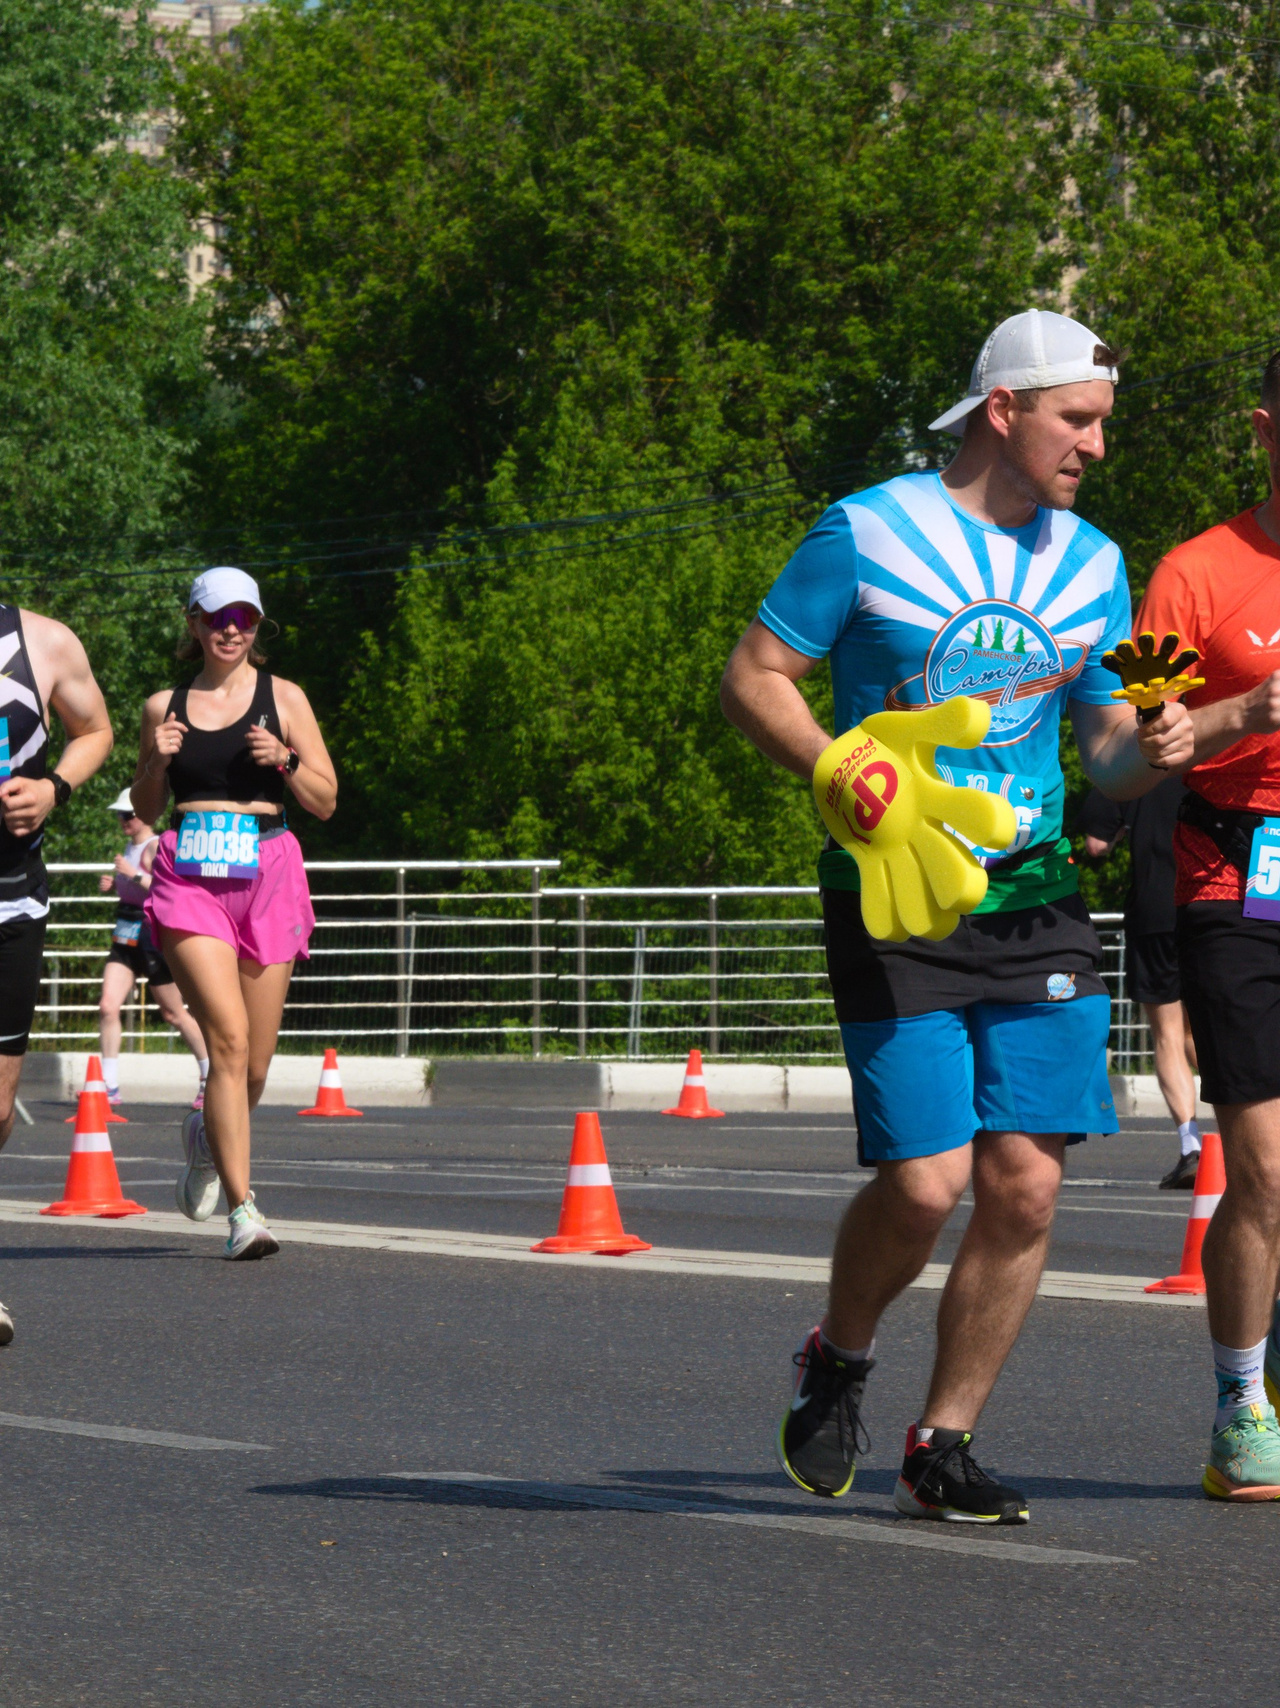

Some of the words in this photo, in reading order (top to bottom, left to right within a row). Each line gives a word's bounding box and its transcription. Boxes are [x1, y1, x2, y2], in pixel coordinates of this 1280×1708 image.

[973, 648, 1022, 663] РАМЕНСКОЕ
[931, 647, 1063, 709] Сатурн
[825, 737, 875, 809] РОССИЯ
[211, 814, 226, 829] 10
[179, 829, 254, 864] 50038
[200, 862, 229, 878] 10KM
